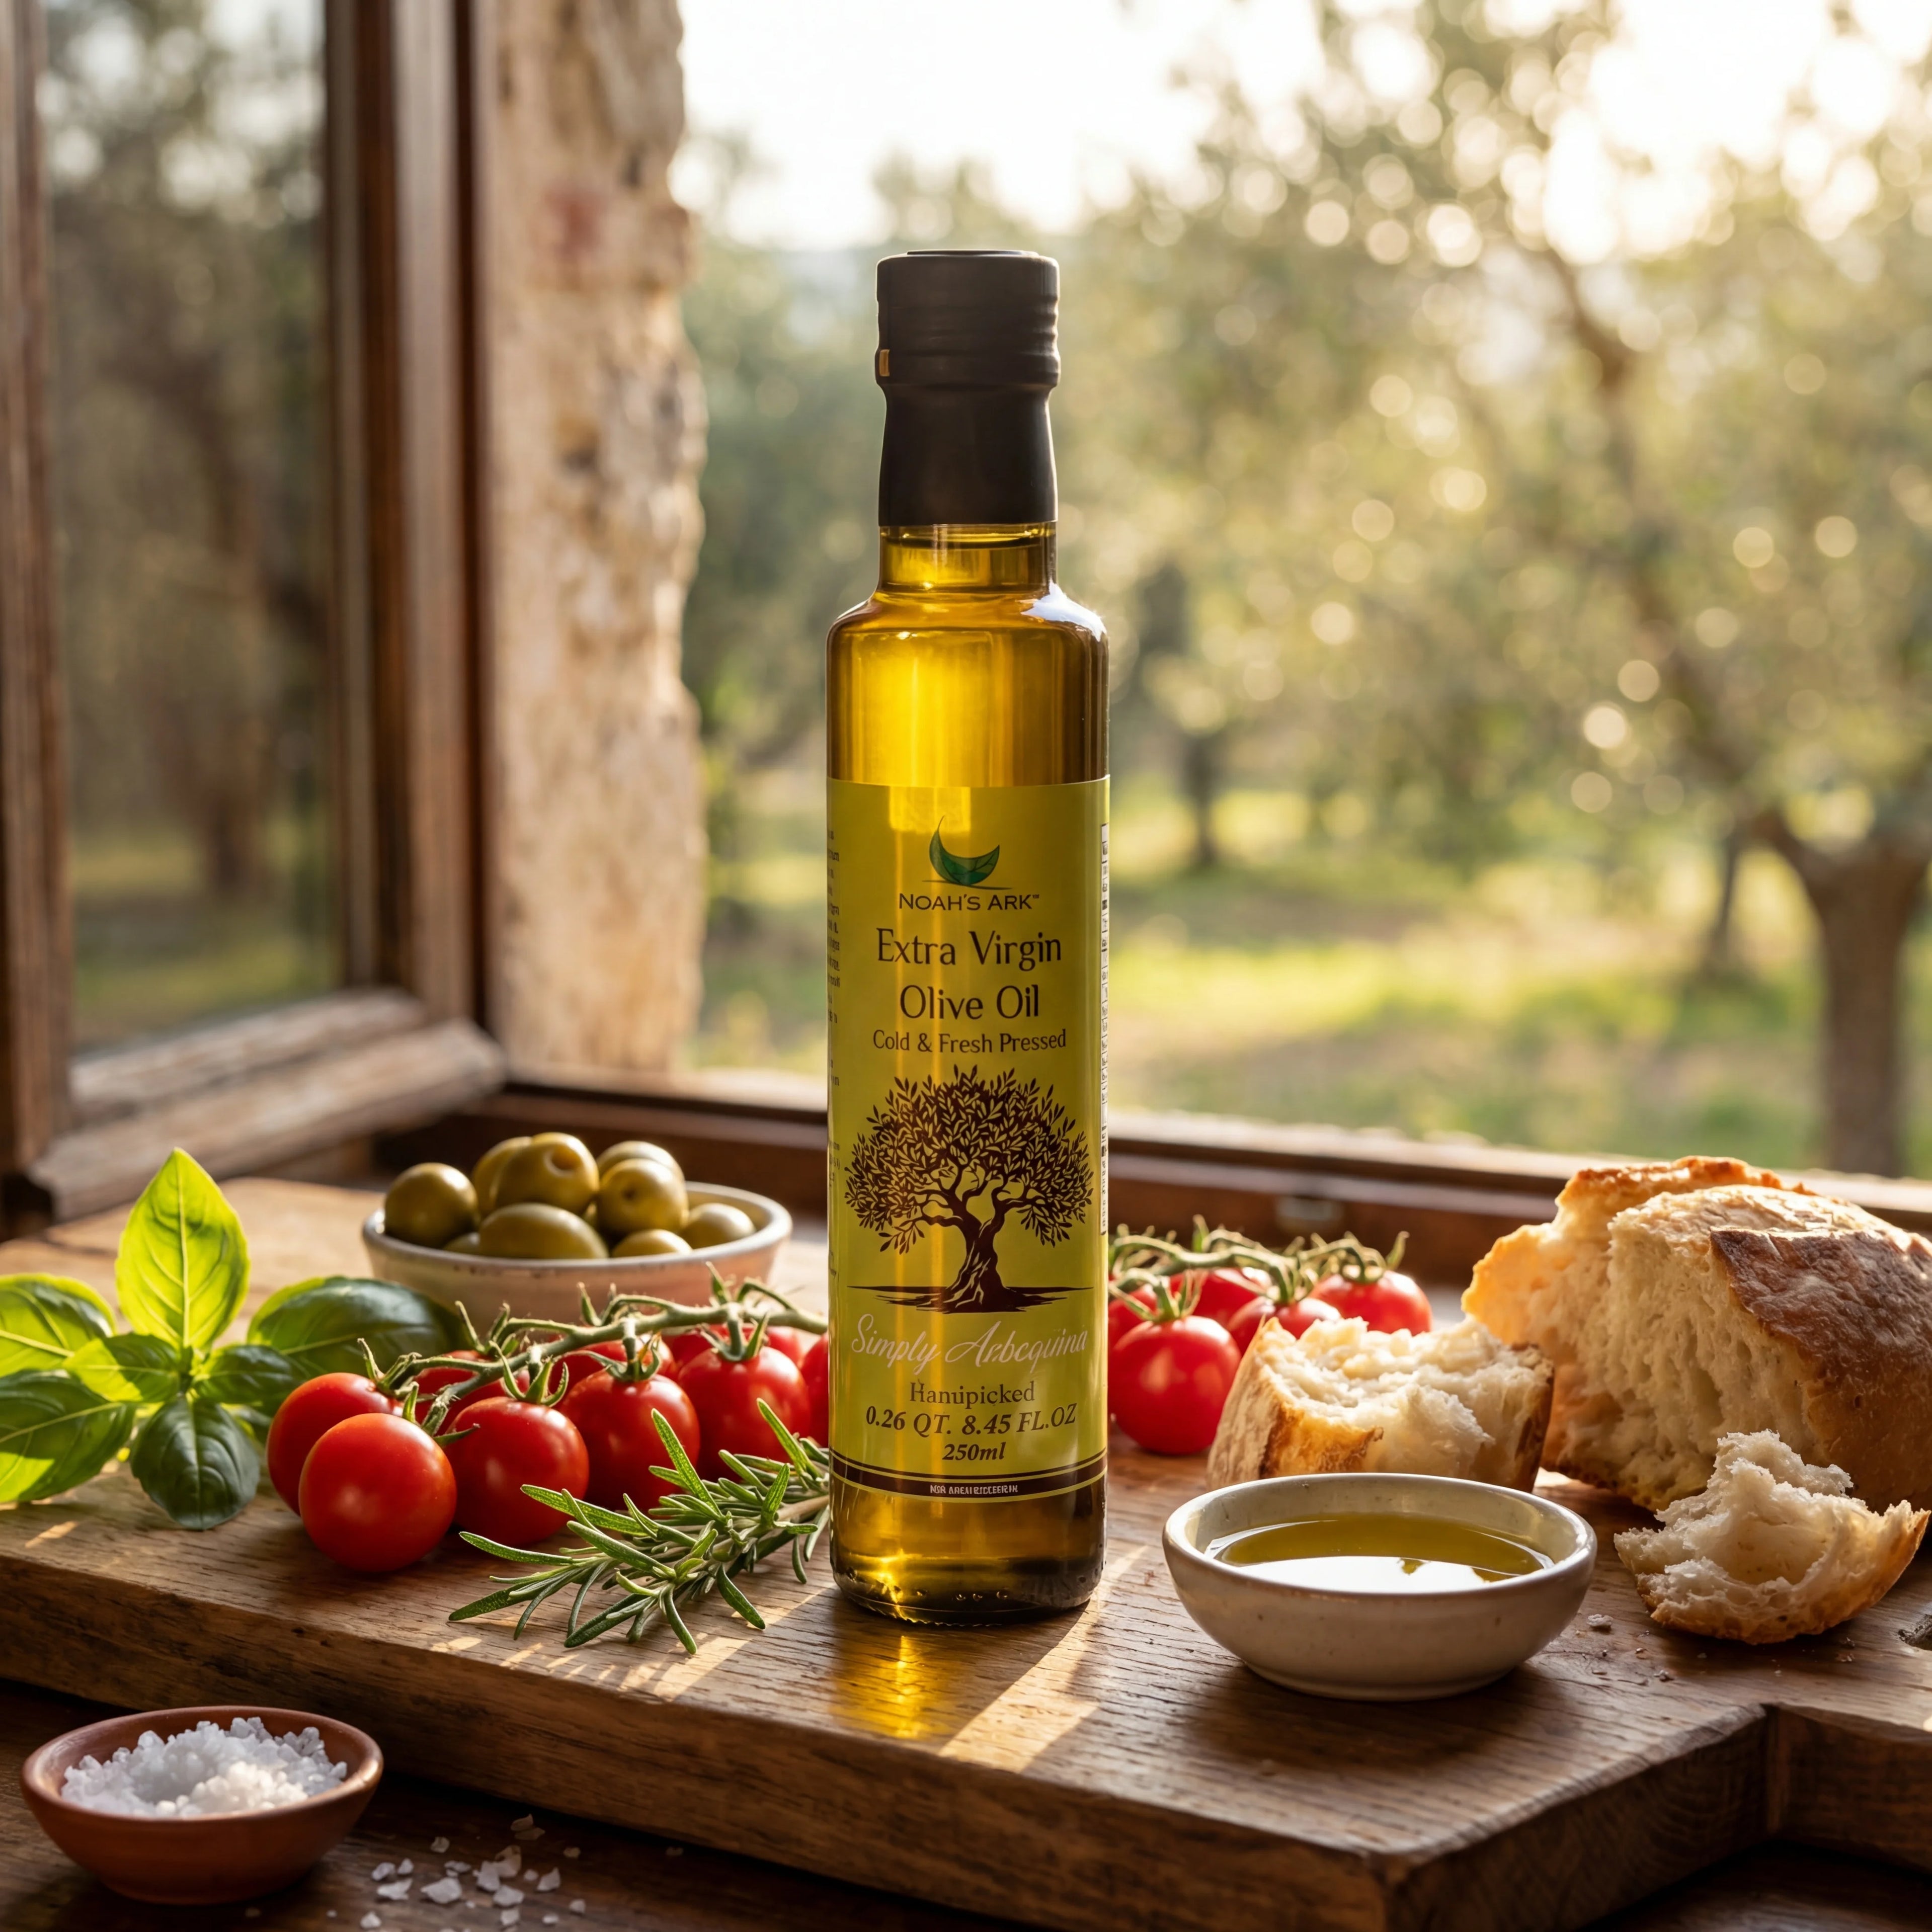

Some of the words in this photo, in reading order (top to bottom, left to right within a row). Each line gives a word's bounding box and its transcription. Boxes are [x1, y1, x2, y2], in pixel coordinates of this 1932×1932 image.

[899, 893, 981, 911] NOAH'S
[876, 928, 956, 965] Extra
[969, 930, 1062, 972] Virgin
[900, 985, 984, 1020] Olive
[996, 985, 1039, 1017] Oil
[873, 1029, 910, 1051] Cold
[917, 1033, 932, 1053] &
[939, 1033, 993, 1054] Fresh
[999, 1028, 1067, 1052] Pressed
[851, 1314, 941, 1376] Simply
[866, 1406, 906, 1430] 0.26
[913, 1413, 951, 1438] QT.
[961, 1413, 1012, 1435] 8.45
[1016, 1403, 1078, 1433] FL.OZ
[942, 1441, 1007, 1461] 250ml
